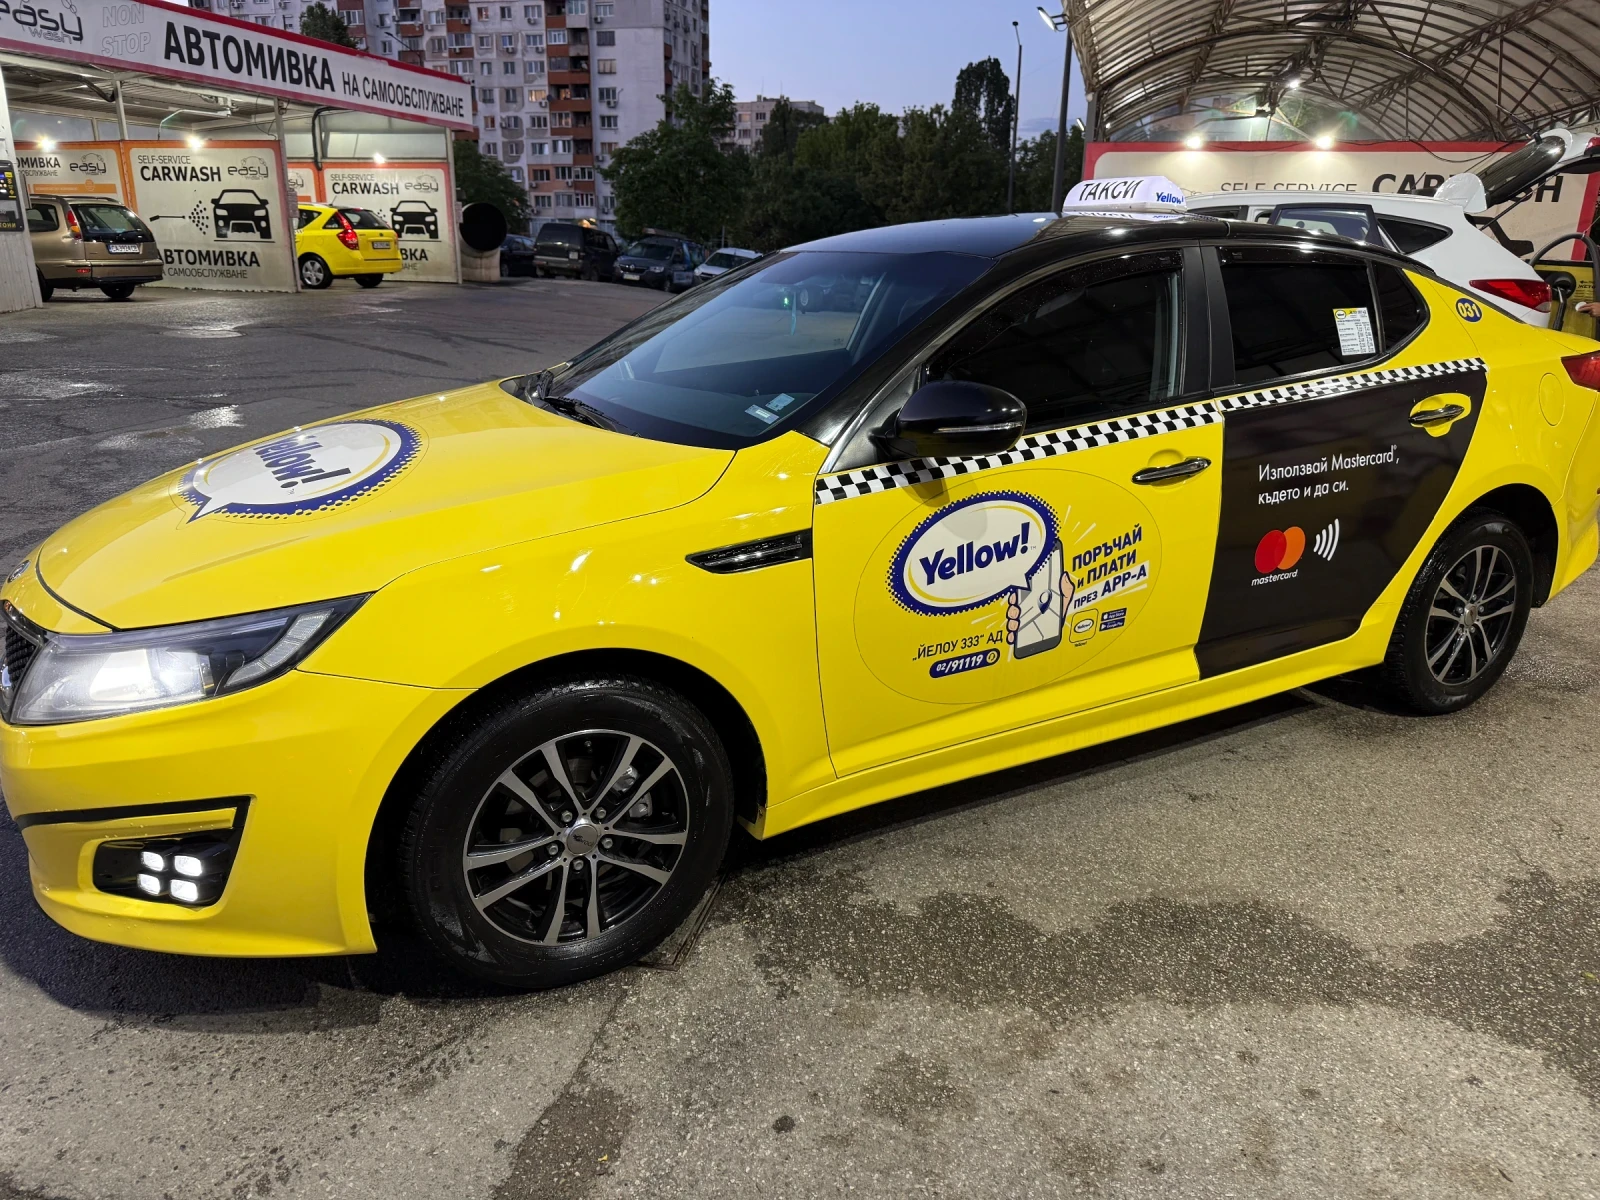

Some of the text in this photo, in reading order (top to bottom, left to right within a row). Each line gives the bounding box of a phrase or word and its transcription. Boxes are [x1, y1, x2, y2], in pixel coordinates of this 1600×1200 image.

[102, 4, 144, 27] NON
[101, 32, 151, 57] STOP
[164, 21, 465, 118] АВТОМИВКА НА САМООБСЛУЖВАНЕ
[138, 155, 191, 164] SELF-SERVICE
[140, 166, 222, 182] CARWASH
[227, 166, 268, 178] easy
[330, 173, 375, 181] SELF-SERVICE
[332, 182, 400, 195] CARWASH
[1079, 180, 1144, 201] ТАКСИ
[168, 268, 248, 279] САМООБСЛУЖВАНЕ
[1457, 302, 1480, 318] 031
[1258, 457, 1328, 482] Използвай
[1258, 480, 1349, 505] където и да си.
[919, 521, 1030, 586] Yellow!
[1072, 523, 1142, 572] ПОРЪЧАЙ
[1087, 549, 1137, 585] ПЛАТИ
[1251, 569, 1298, 587] mastercard
[1074, 590, 1098, 609] ПРЕЗ
[986, 630, 1003, 644] АД
[936, 654, 984, 673] 02/91119
